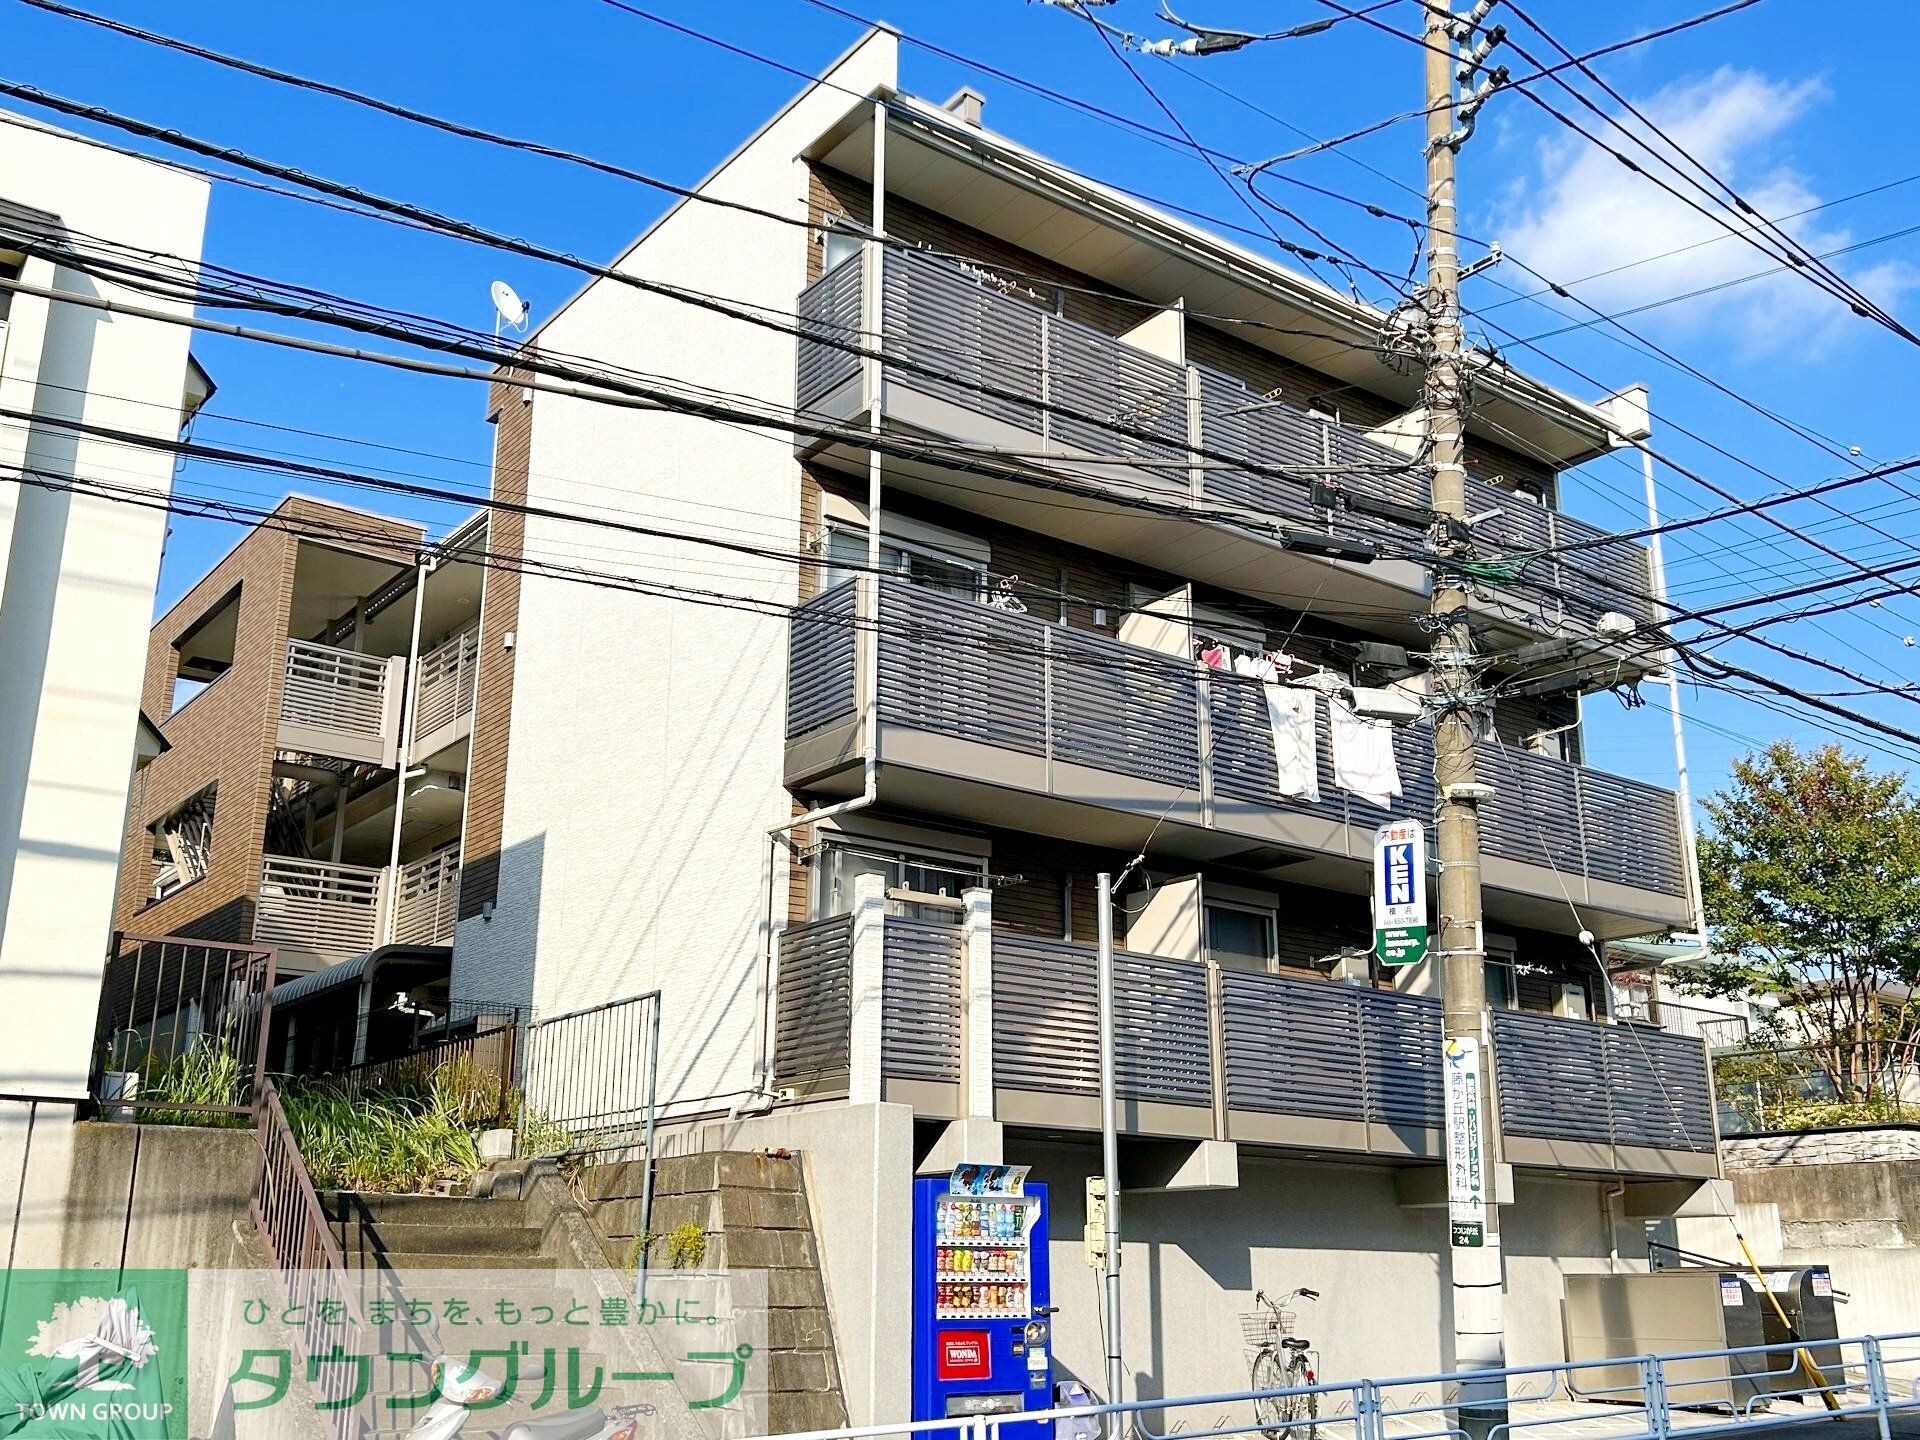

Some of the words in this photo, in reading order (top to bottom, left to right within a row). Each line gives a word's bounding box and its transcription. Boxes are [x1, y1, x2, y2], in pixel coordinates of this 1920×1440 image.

[1381, 829, 1416, 841] 不動産は
[1389, 844, 1410, 905] KEN
[1451, 1072, 1468, 1192] 藤が丘駅整形外科
[1453, 1226, 1479, 1236] つつじが丘
[1458, 1235, 1470, 1245] 24
[949, 1349, 977, 1359] WONDA
